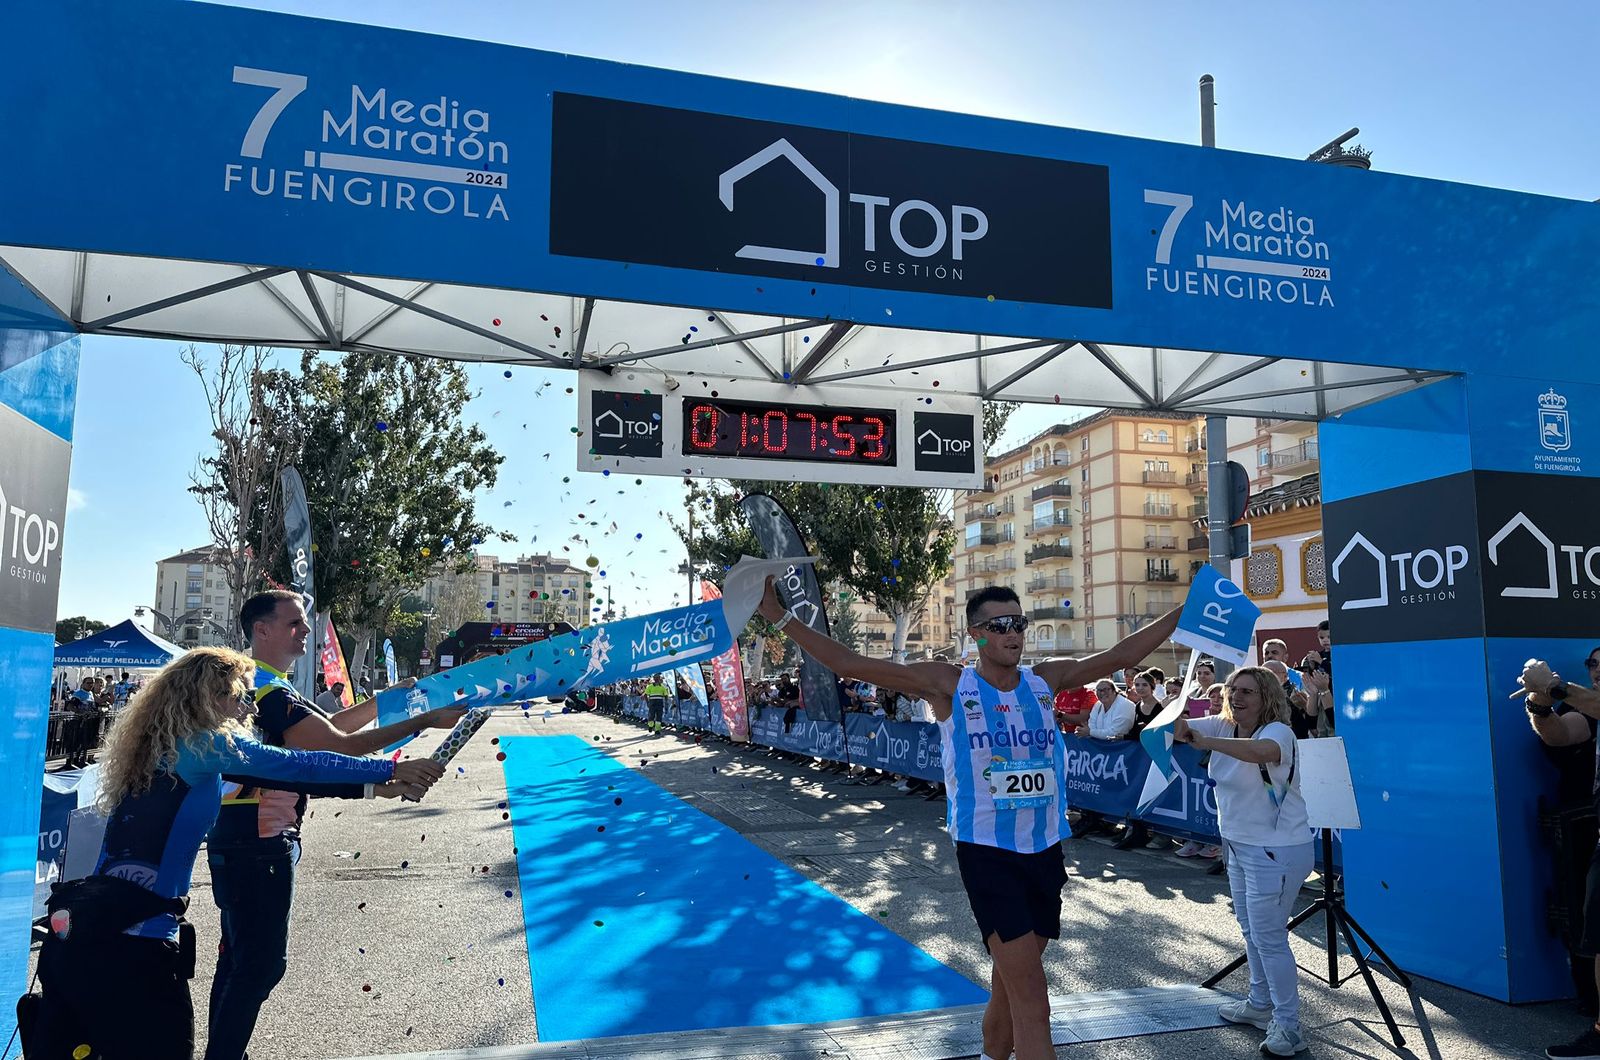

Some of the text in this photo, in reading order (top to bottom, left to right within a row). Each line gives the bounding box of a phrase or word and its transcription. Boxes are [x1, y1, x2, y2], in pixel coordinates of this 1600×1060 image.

[352, 84, 489, 133] Media
[322, 109, 509, 164] Maratón
[466, 171, 503, 187] 2024
[224, 163, 510, 221] FUENGIROLA
[849, 193, 989, 260] TOP
[1222, 199, 1315, 236] Media
[1205, 221, 1329, 261] Maratón
[865, 260, 963, 281] GESTIÓN
[1302, 267, 1328, 279] 2024
[1146, 267, 1335, 308] FUENGIROLA
[691, 405, 884, 458] 01:07:53
[942, 438, 971, 453] TOP
[1534, 455, 1581, 464] AYUNTAMIENTO
[1544, 463, 1581, 472] FUENGIROLA
[10, 505, 59, 568] TOP
[10, 565, 47, 584] GESTIÓN
[1391, 545, 1469, 591] TOP
[1401, 590, 1456, 605] GESTIÓN
[1573, 590, 1600, 600] GES
[643, 612, 709, 636] Media
[631, 625, 716, 660] Maratón
[102, 656, 113, 664] DE
[114, 657, 161, 665] MEDALLAS
[889, 737, 910, 760] TOP
[1006, 772, 1045, 794] 200
[1068, 779, 1101, 794] DEPORTE
[39, 829, 62, 851] TO
[35, 858, 60, 884] LA
